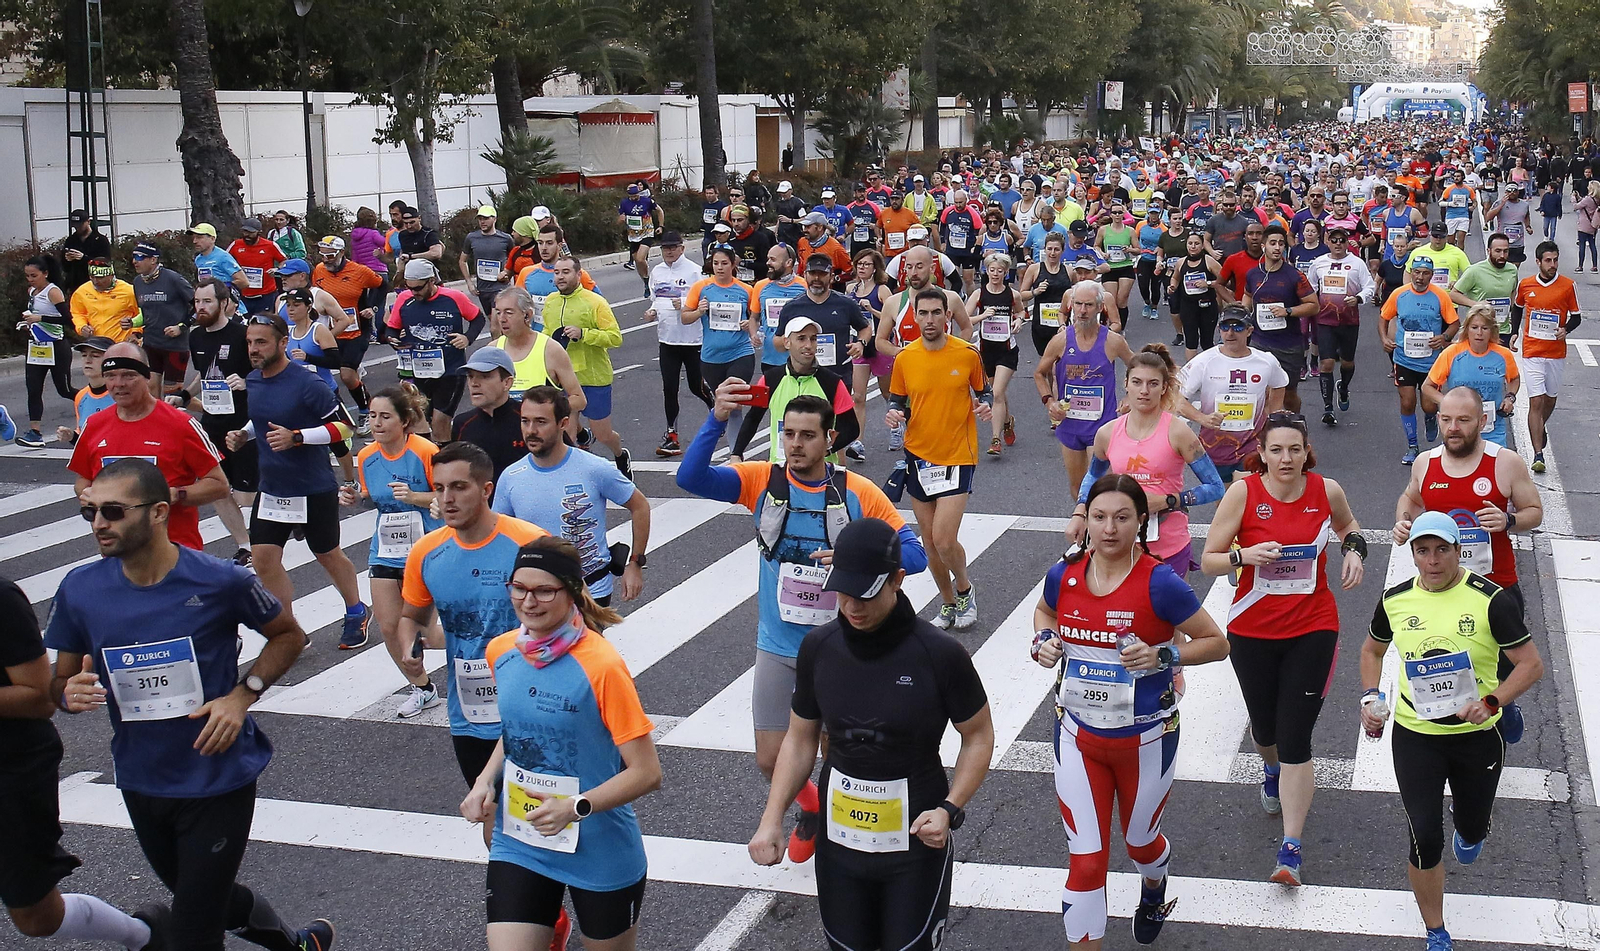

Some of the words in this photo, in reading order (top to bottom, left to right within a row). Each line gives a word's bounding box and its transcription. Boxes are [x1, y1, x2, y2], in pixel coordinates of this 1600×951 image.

[930, 470, 945, 479] 3058
[276, 498, 291, 506] 4752
[390, 532, 408, 540] 4748
[804, 570, 828, 579] ZURIC
[1274, 565, 1297, 575] 2504
[796, 591, 820, 602] 4581
[1060, 624, 1119, 643] FRANCES
[136, 650, 170, 662] ZURICH
[1428, 661, 1454, 671] ZURICH
[1089, 668, 1117, 677] ZURICH
[137, 675, 169, 690] 3176
[1429, 680, 1454, 693] 3042
[475, 686, 498, 697] 4786
[538, 691, 562, 701] ZURICH
[1083, 689, 1109, 702] 2959
[526, 775, 557, 788] ZURICH
[853, 783, 887, 794] ZURICH
[849, 809, 879, 823] 4073
